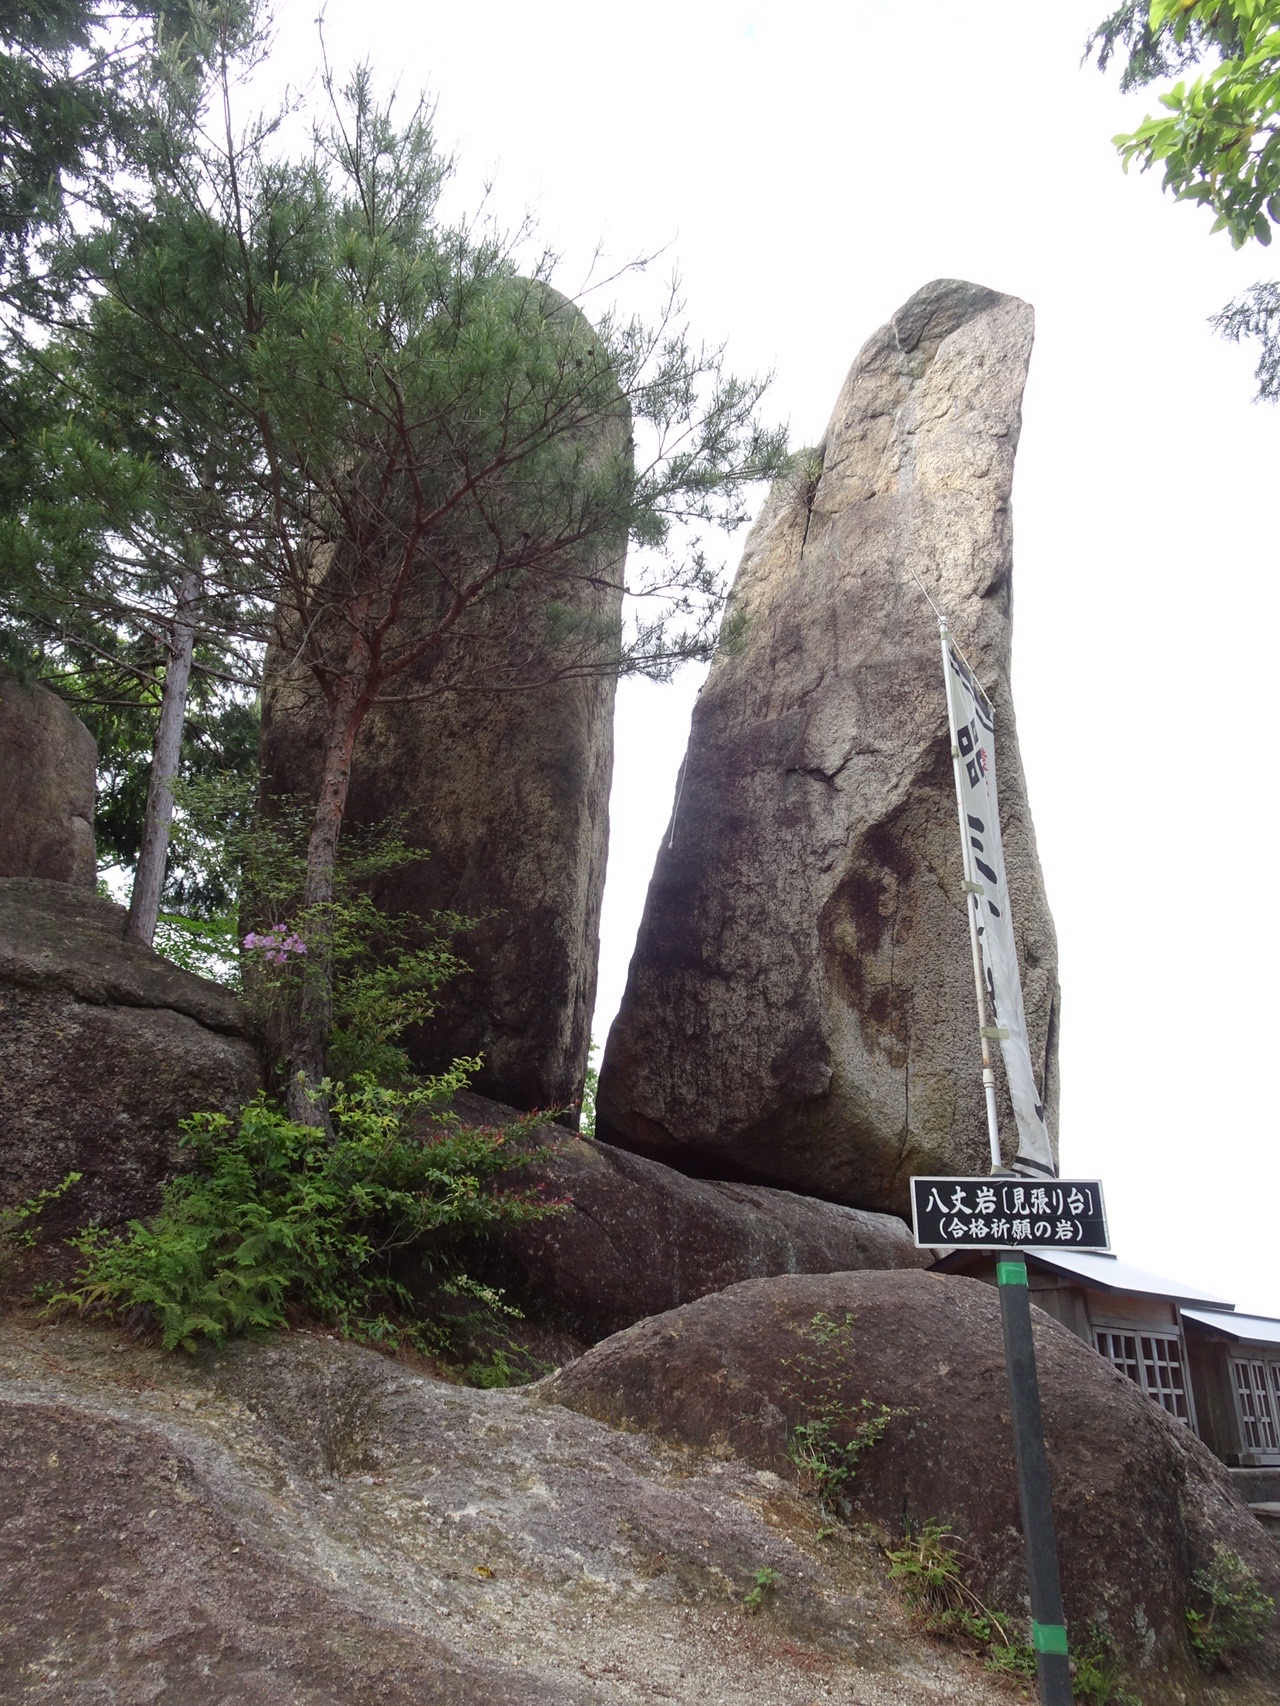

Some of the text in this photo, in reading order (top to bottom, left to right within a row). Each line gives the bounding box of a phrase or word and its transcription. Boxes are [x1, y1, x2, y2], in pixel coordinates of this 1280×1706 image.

[939, 1217, 1083, 1241] (合格祈願の岩)
